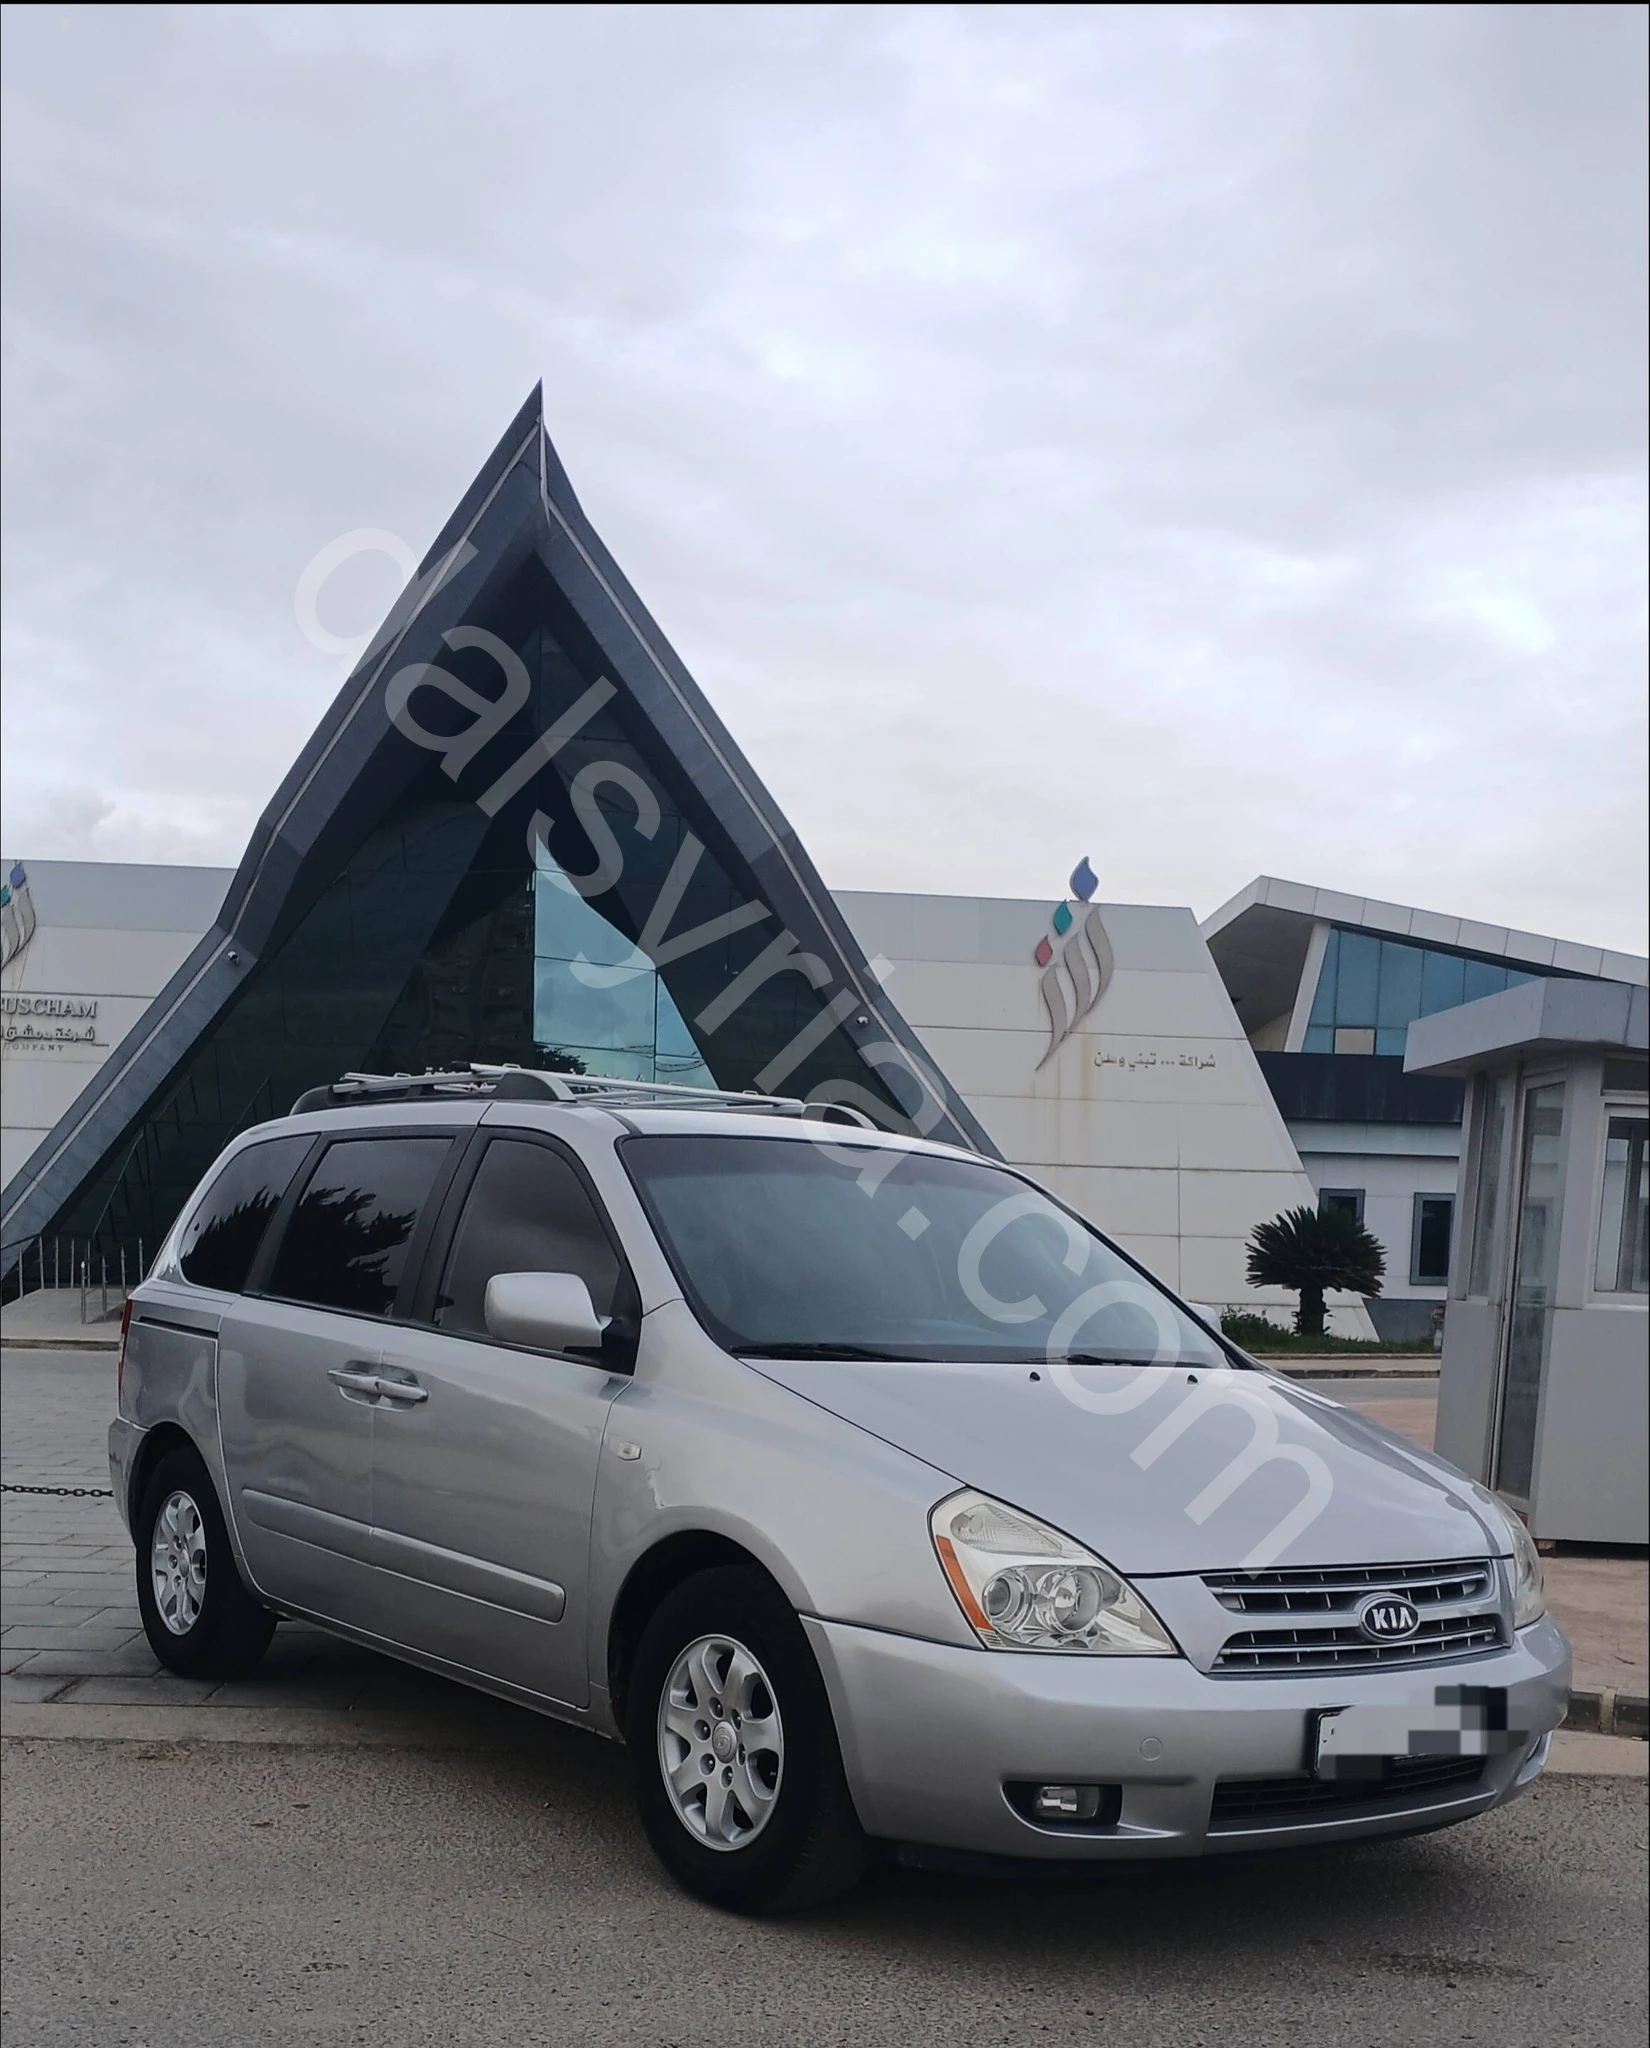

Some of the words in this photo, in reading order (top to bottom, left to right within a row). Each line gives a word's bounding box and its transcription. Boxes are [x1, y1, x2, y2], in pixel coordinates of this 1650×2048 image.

[1, 998, 98, 1018] USCHAM
[1178, 1053, 1216, 1069] شراكة
[1372, 1606, 1413, 1630] KIA
